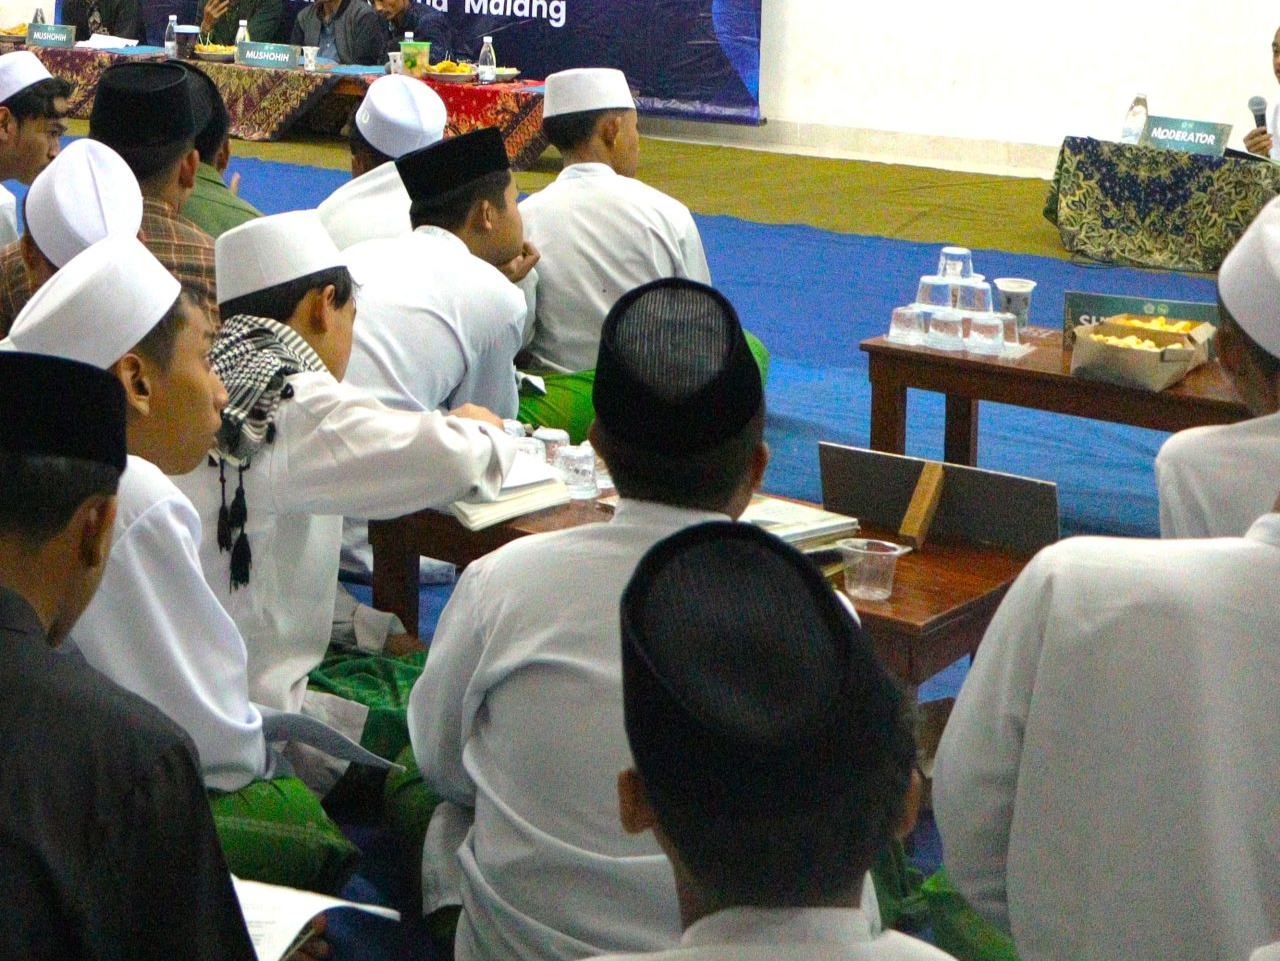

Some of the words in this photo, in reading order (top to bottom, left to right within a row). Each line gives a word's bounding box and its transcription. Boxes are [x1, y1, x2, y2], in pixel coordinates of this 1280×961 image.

[33, 31, 67, 41] MUSHOHIH
[245, 50, 290, 62] MUSHOHIH
[1150, 127, 1216, 145] MODERATOR
